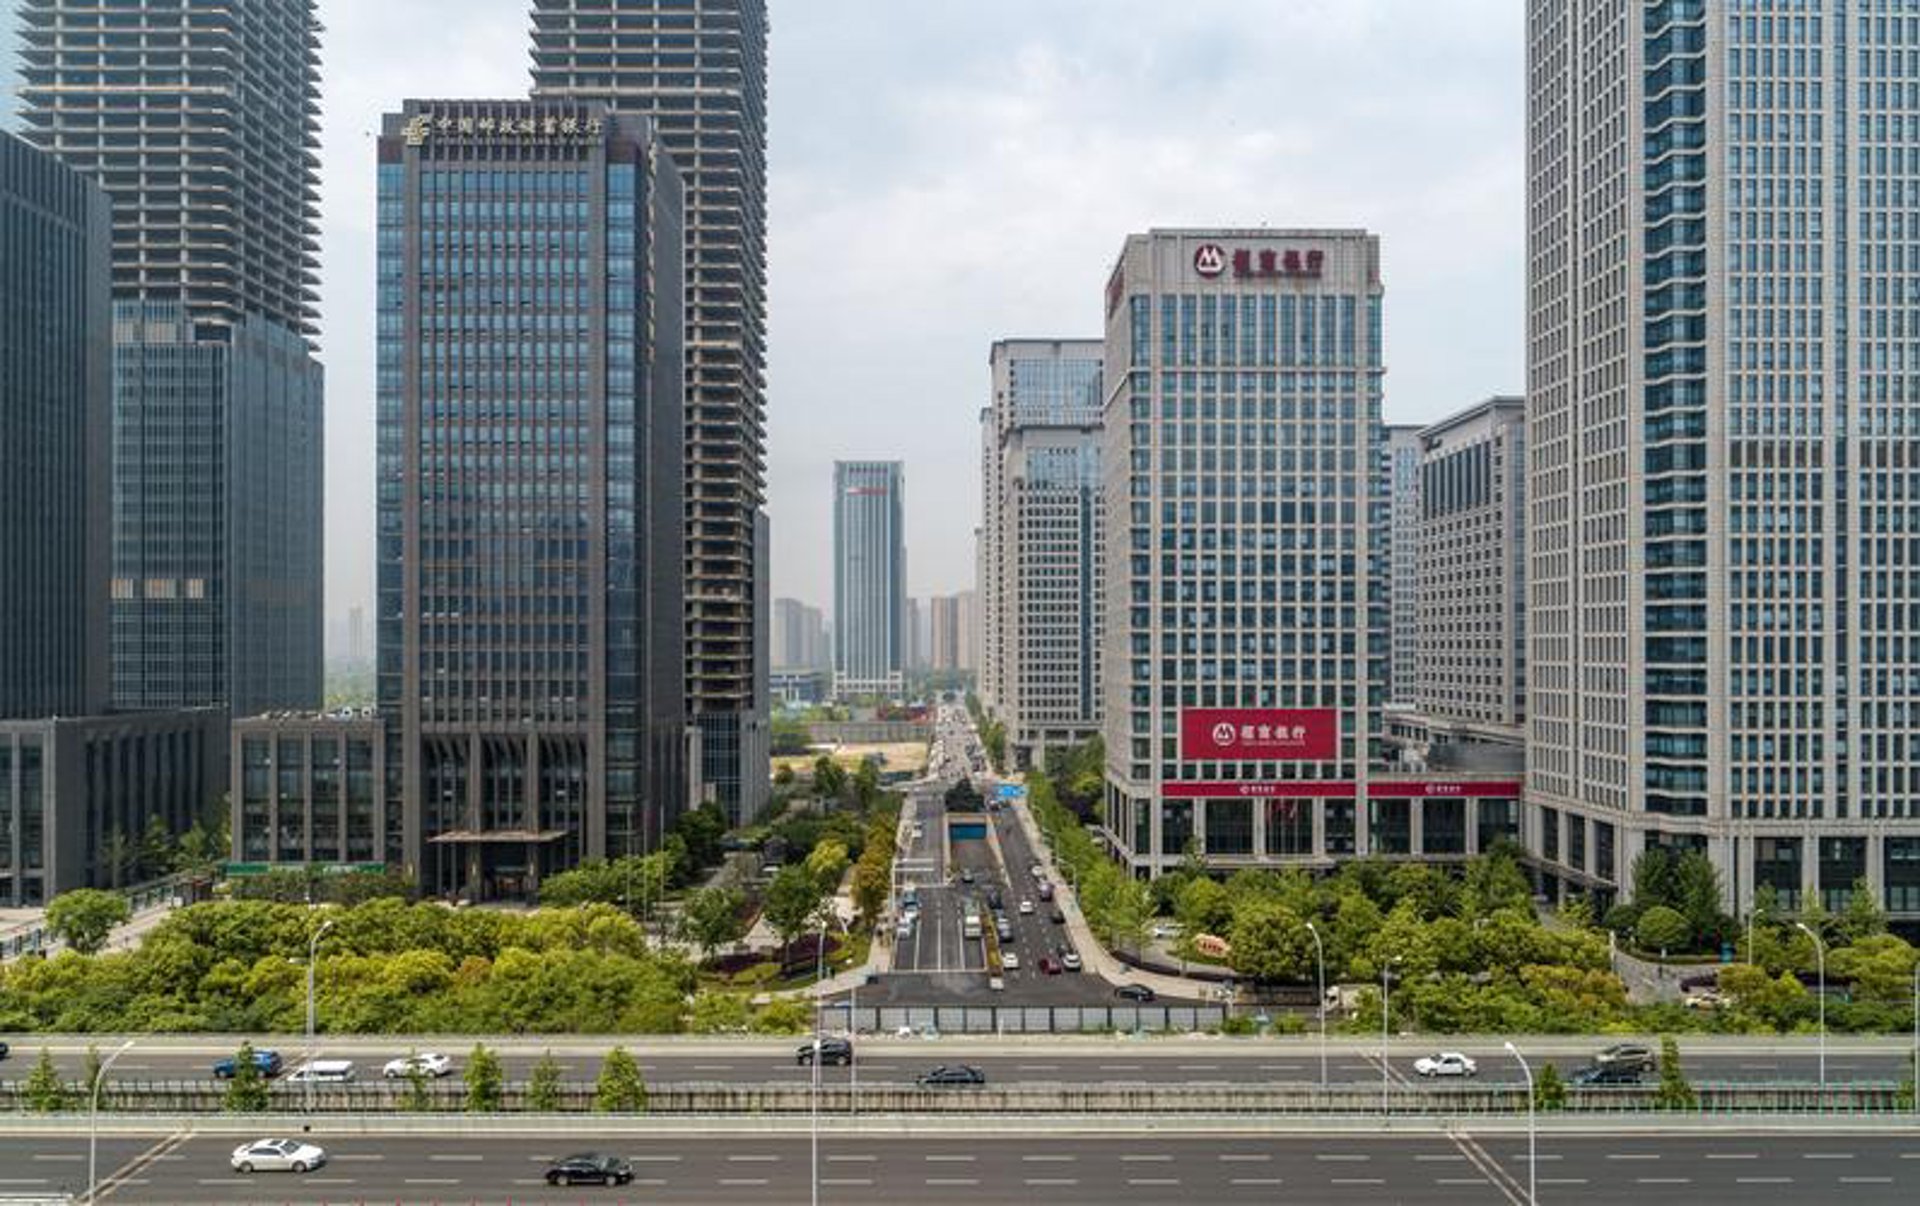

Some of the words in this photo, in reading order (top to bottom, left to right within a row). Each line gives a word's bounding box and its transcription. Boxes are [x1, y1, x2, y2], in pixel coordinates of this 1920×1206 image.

[437, 116, 602, 135] 中国邮政储蓄银行
[1240, 724, 1307, 740] 招商银行
